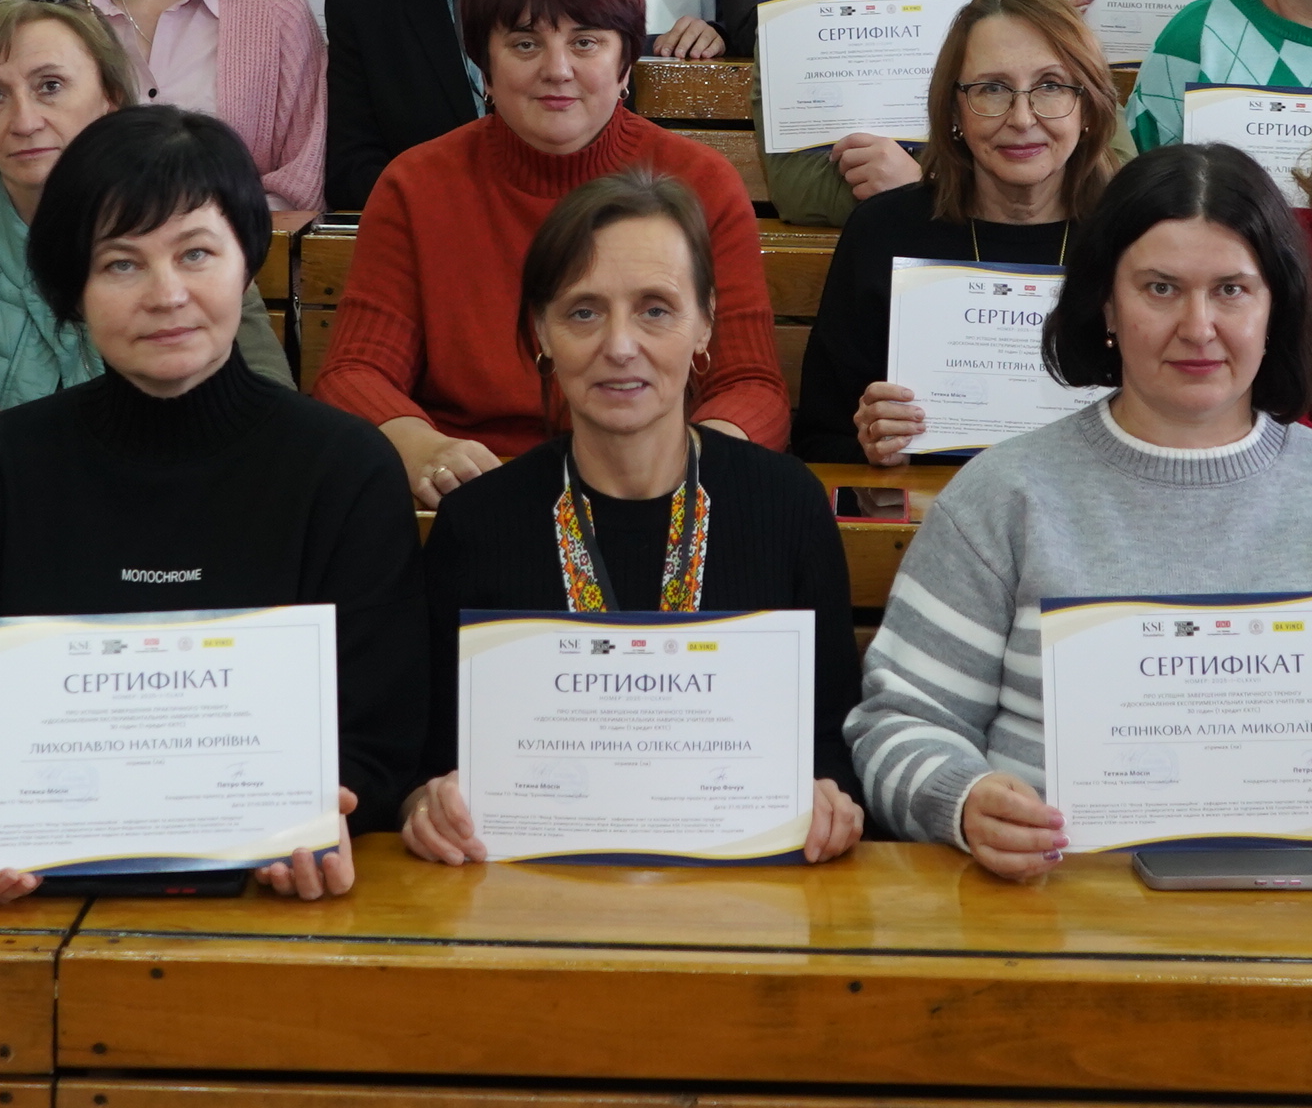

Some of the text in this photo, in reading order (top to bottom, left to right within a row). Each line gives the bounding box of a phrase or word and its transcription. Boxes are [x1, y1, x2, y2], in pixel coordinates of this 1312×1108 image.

[818, 25, 921, 42] СЕРТИФІКАТ
[804, 71, 854, 80] ДІЯКОНЮК
[857, 69, 884, 77] ТАРАС
[969, 282, 986, 290] KSE
[946, 359, 993, 370] ЦИМБАЛ
[997, 362, 1035, 371] ТЕТЯНА
[121, 568, 202, 583] MONOCHROME
[1142, 622, 1165, 633] KSE
[1275, 622, 1303, 631] DA VINCI
[69, 640, 92, 652] KSE
[559, 639, 581, 650] KSE
[1140, 653, 1304, 677] СЕРТИФІКАТ
[63, 667, 234, 695] СЕРТИФІКАТ
[555, 673, 716, 693] СЕРТИФІКАТ
[1111, 724, 1191, 737] РЄПНІКОВА
[1196, 723, 1237, 736] АЛЛА
[30, 734, 260, 754] ЛИХОПАВЛО НАТАЛІЯ ЮРІЇВНА
[590, 740, 632, 751] ІРИНА
[637, 740, 752, 753] ОЛЕКСАНДРІВНА
